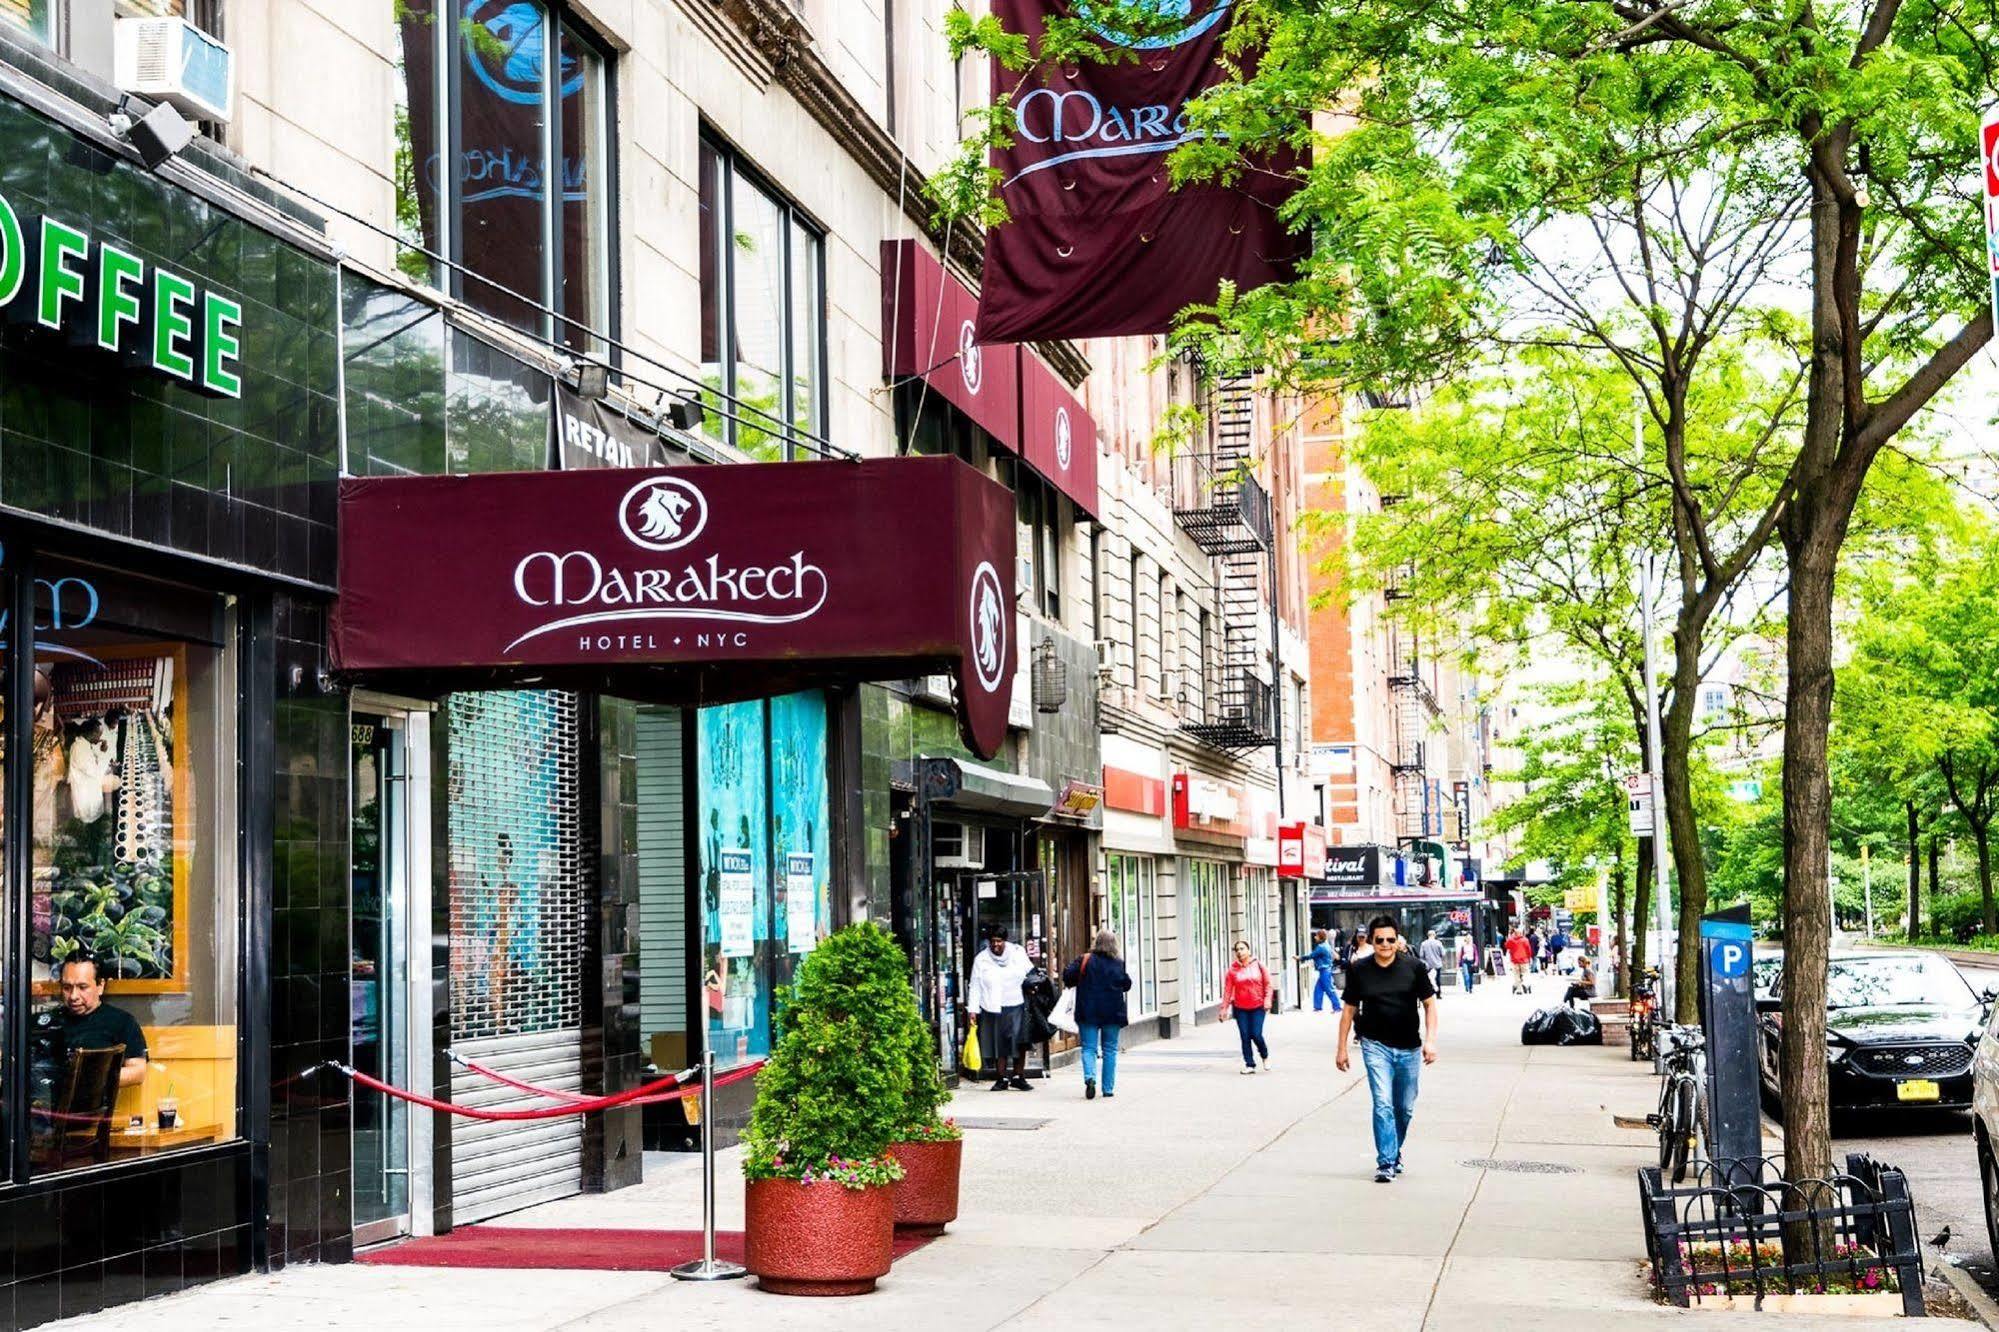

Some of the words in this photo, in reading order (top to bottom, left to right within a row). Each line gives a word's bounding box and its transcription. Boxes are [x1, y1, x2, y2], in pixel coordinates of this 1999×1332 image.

[579, 634, 657, 650] HOTEL
[697, 632, 748, 647] NYC
[351, 726, 371, 742] 688
[1723, 944, 1743, 973] P
